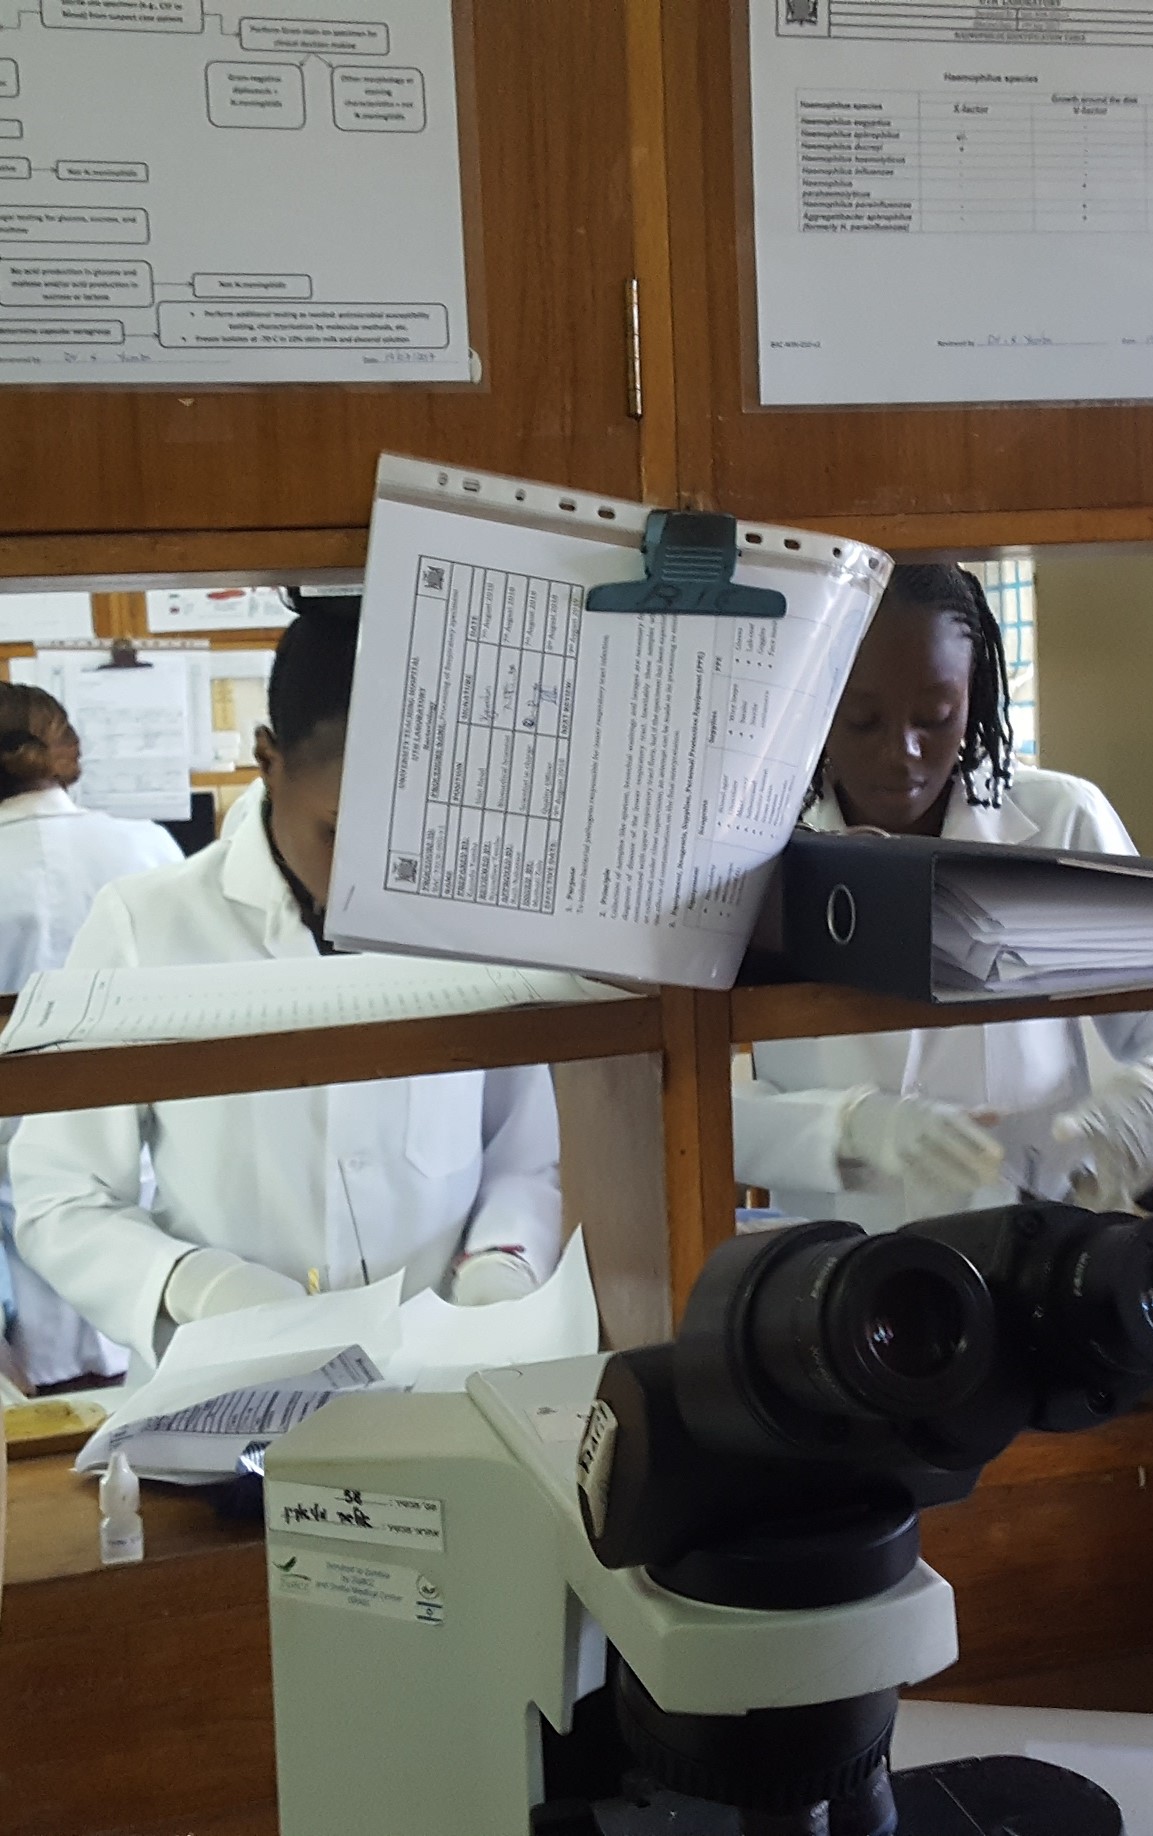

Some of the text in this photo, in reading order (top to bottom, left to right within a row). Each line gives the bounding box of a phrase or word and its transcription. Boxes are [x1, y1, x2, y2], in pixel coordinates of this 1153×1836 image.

[944, 73, 1039, 84] Haemophilus species
[800, 100, 851, 111] Haemophilus
[468, 614, 478, 637] DATE
[481, 602, 493, 629] August
[504, 606, 515, 633] August
[525, 610, 536, 637] August
[546, 614, 558, 641] August
[568, 617, 579, 644] August
[397, 654, 419, 789] UNIVERSITY TEACHING HOSPITAL
[411, 686, 427, 762] UTH LABORATORY
[707, 709, 719, 744] Supplies
[452, 760, 463, 801] POSITION
[553, 776, 565, 805] August
[565, 864, 577, 900] Purpose
[599, 867, 613, 905] Principle
